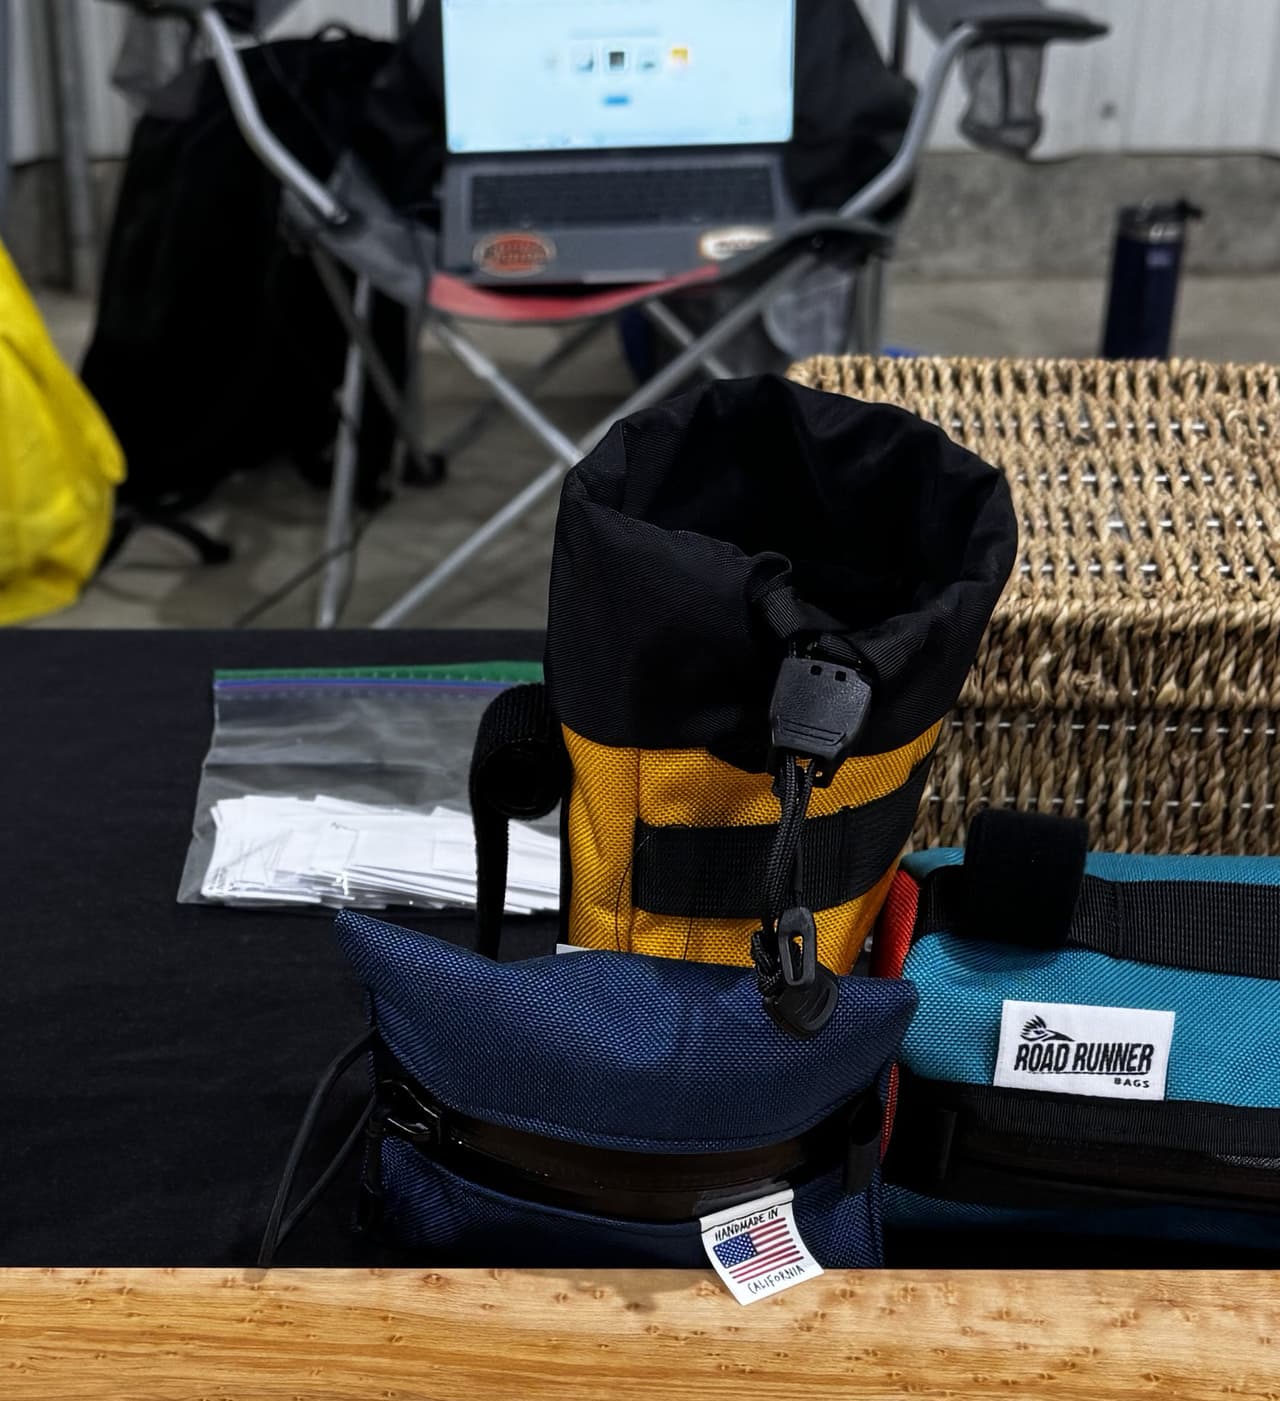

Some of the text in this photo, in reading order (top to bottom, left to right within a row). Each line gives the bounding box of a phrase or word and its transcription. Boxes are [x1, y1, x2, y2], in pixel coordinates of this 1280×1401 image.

[1014, 1042, 1154, 1074] ROAD RUNNER
[1114, 1077, 1150, 1088] BAGS
[714, 1207, 779, 1241] HANDMADE IN
[747, 1264, 805, 1294] CALIFORNIA
